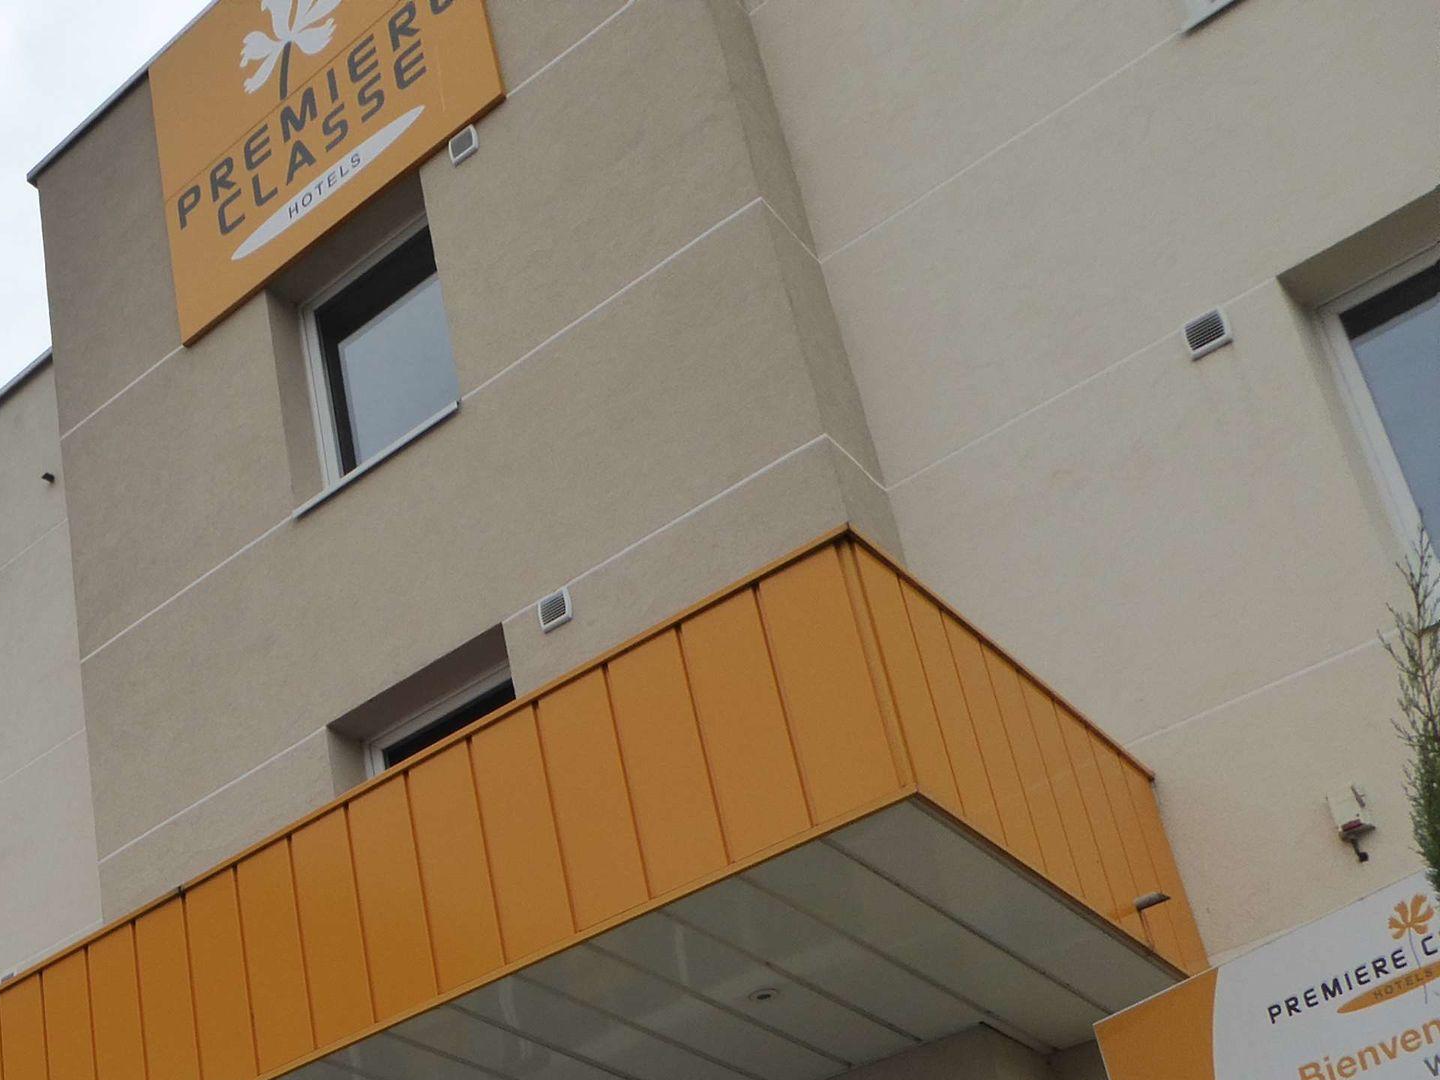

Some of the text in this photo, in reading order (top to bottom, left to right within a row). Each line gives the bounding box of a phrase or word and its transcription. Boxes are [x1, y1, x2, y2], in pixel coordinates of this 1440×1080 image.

[176, 0, 453, 230] PREMIER
[217, 38, 427, 236] CLASSE
[287, 153, 361, 219] HOTELS
[1267, 949, 1408, 1024] PREMIERE
[1373, 969, 1433, 1000] HOTELS
